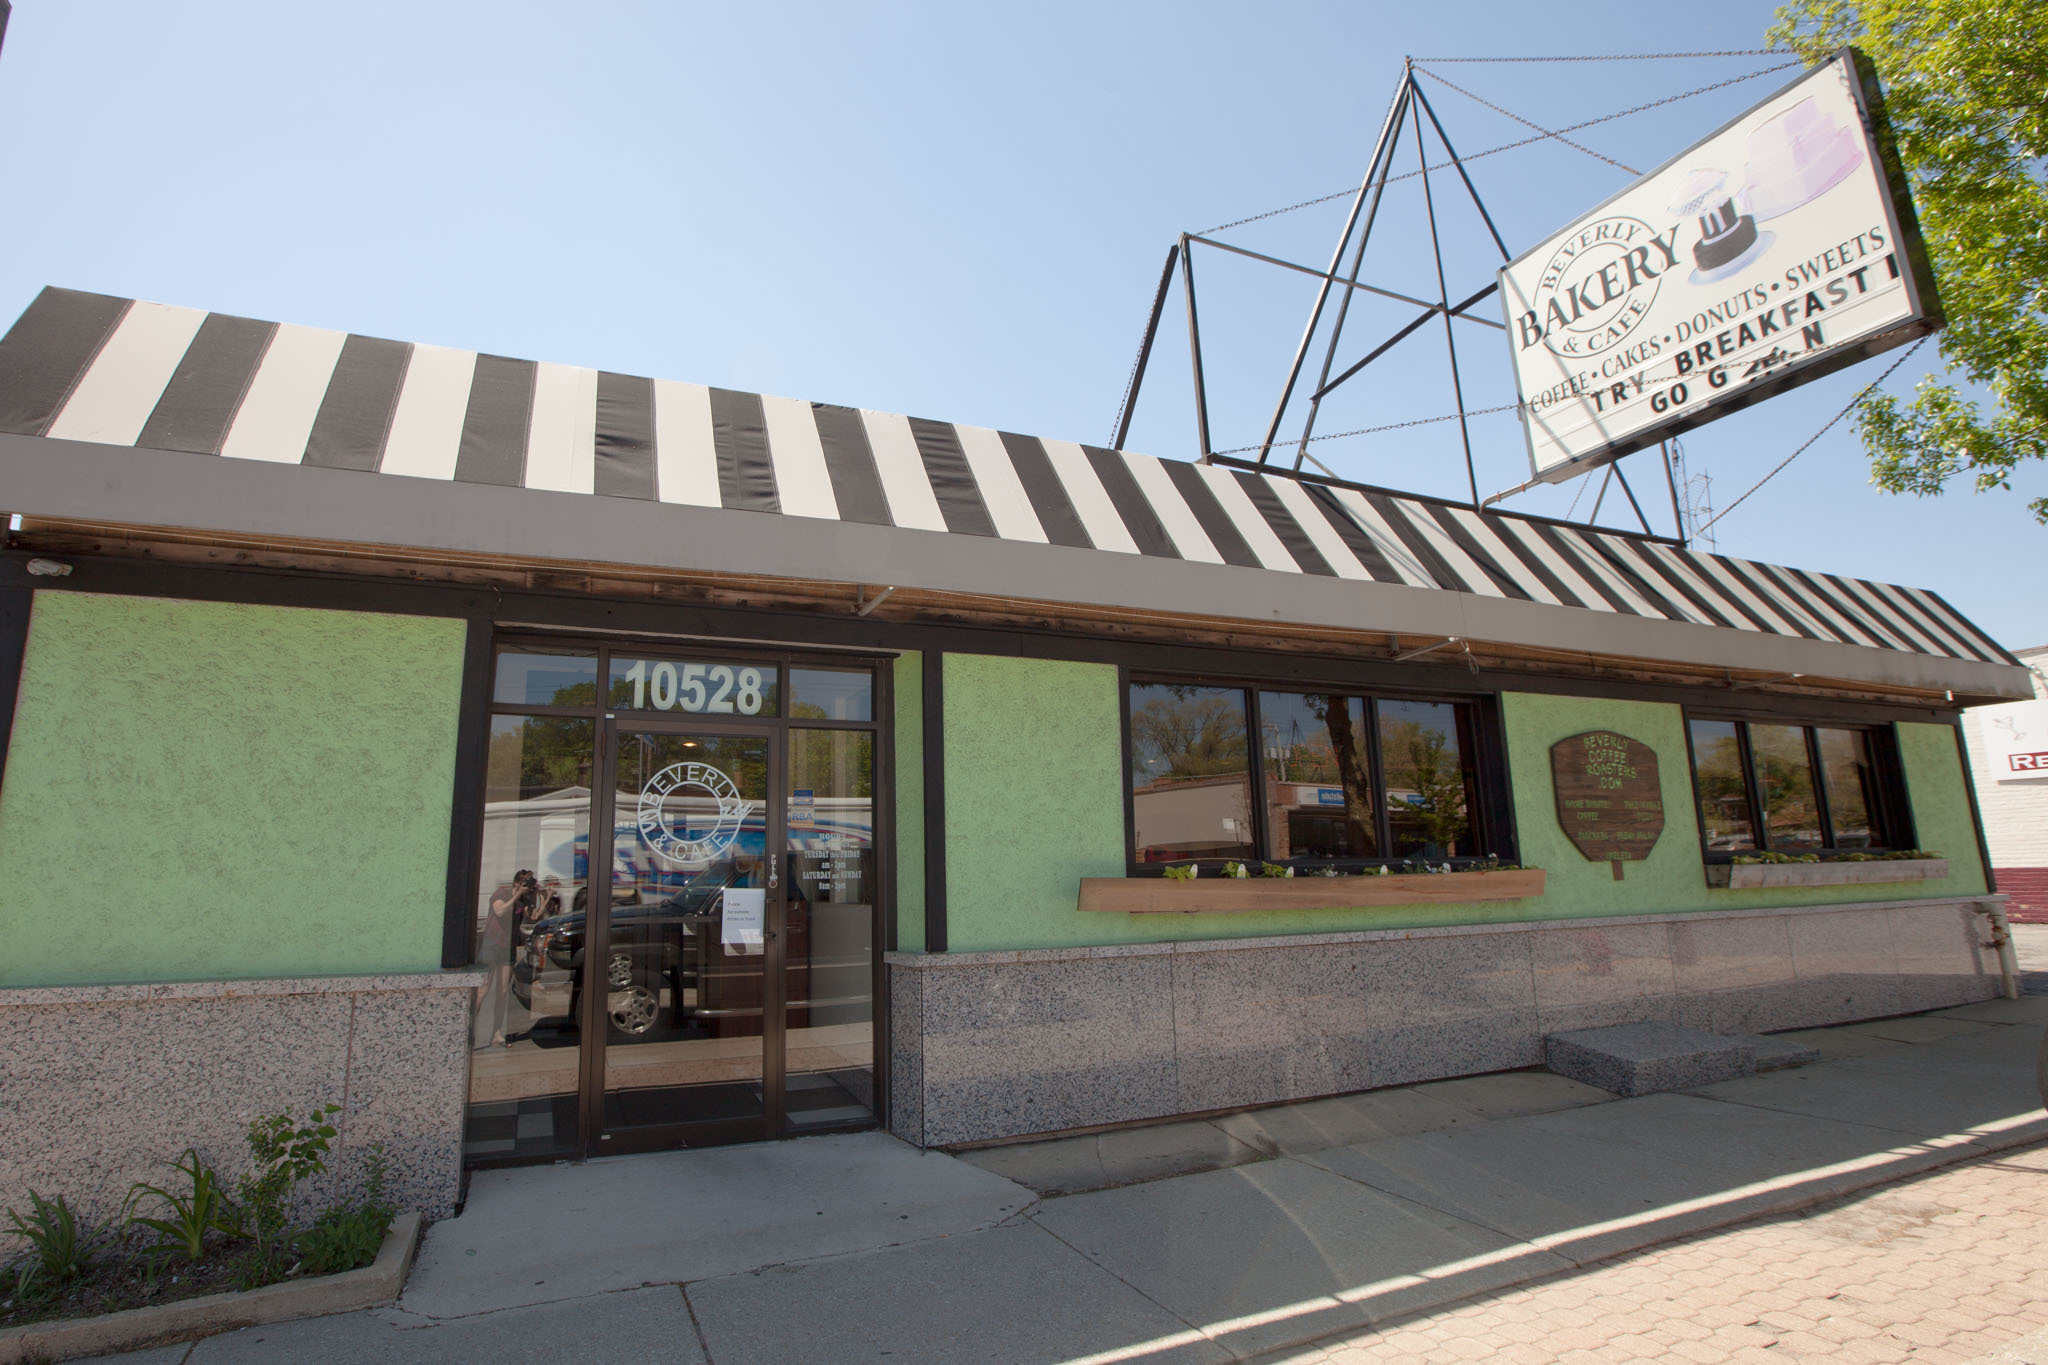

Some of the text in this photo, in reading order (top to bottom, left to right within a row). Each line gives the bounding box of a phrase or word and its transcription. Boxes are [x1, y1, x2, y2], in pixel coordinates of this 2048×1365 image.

[1542, 223, 1642, 289] BEVERLY
[1516, 223, 1680, 351] BAKERY
[1530, 226, 1885, 414] COFFEE CAKES DONUTS SWEETS
[1563, 299, 1647, 353] & CAFE
[1591, 371, 1645, 412] TRY
[1674, 265, 1868, 375] BREAKFAST
[1650, 383, 1688, 413] GO
[625, 660, 763, 715] 10528
[1584, 735, 1630, 750] BEVERLY
[1588, 749, 1627, 763] COFFEE
[643, 765, 738, 806] BEVERLY
[1586, 763, 1637, 779] ROASTERS
[653, 832, 728, 860] & CAFE
[804, 850, 829, 858] TUESDAY
[802, 871, 831, 880] SATURDAY
